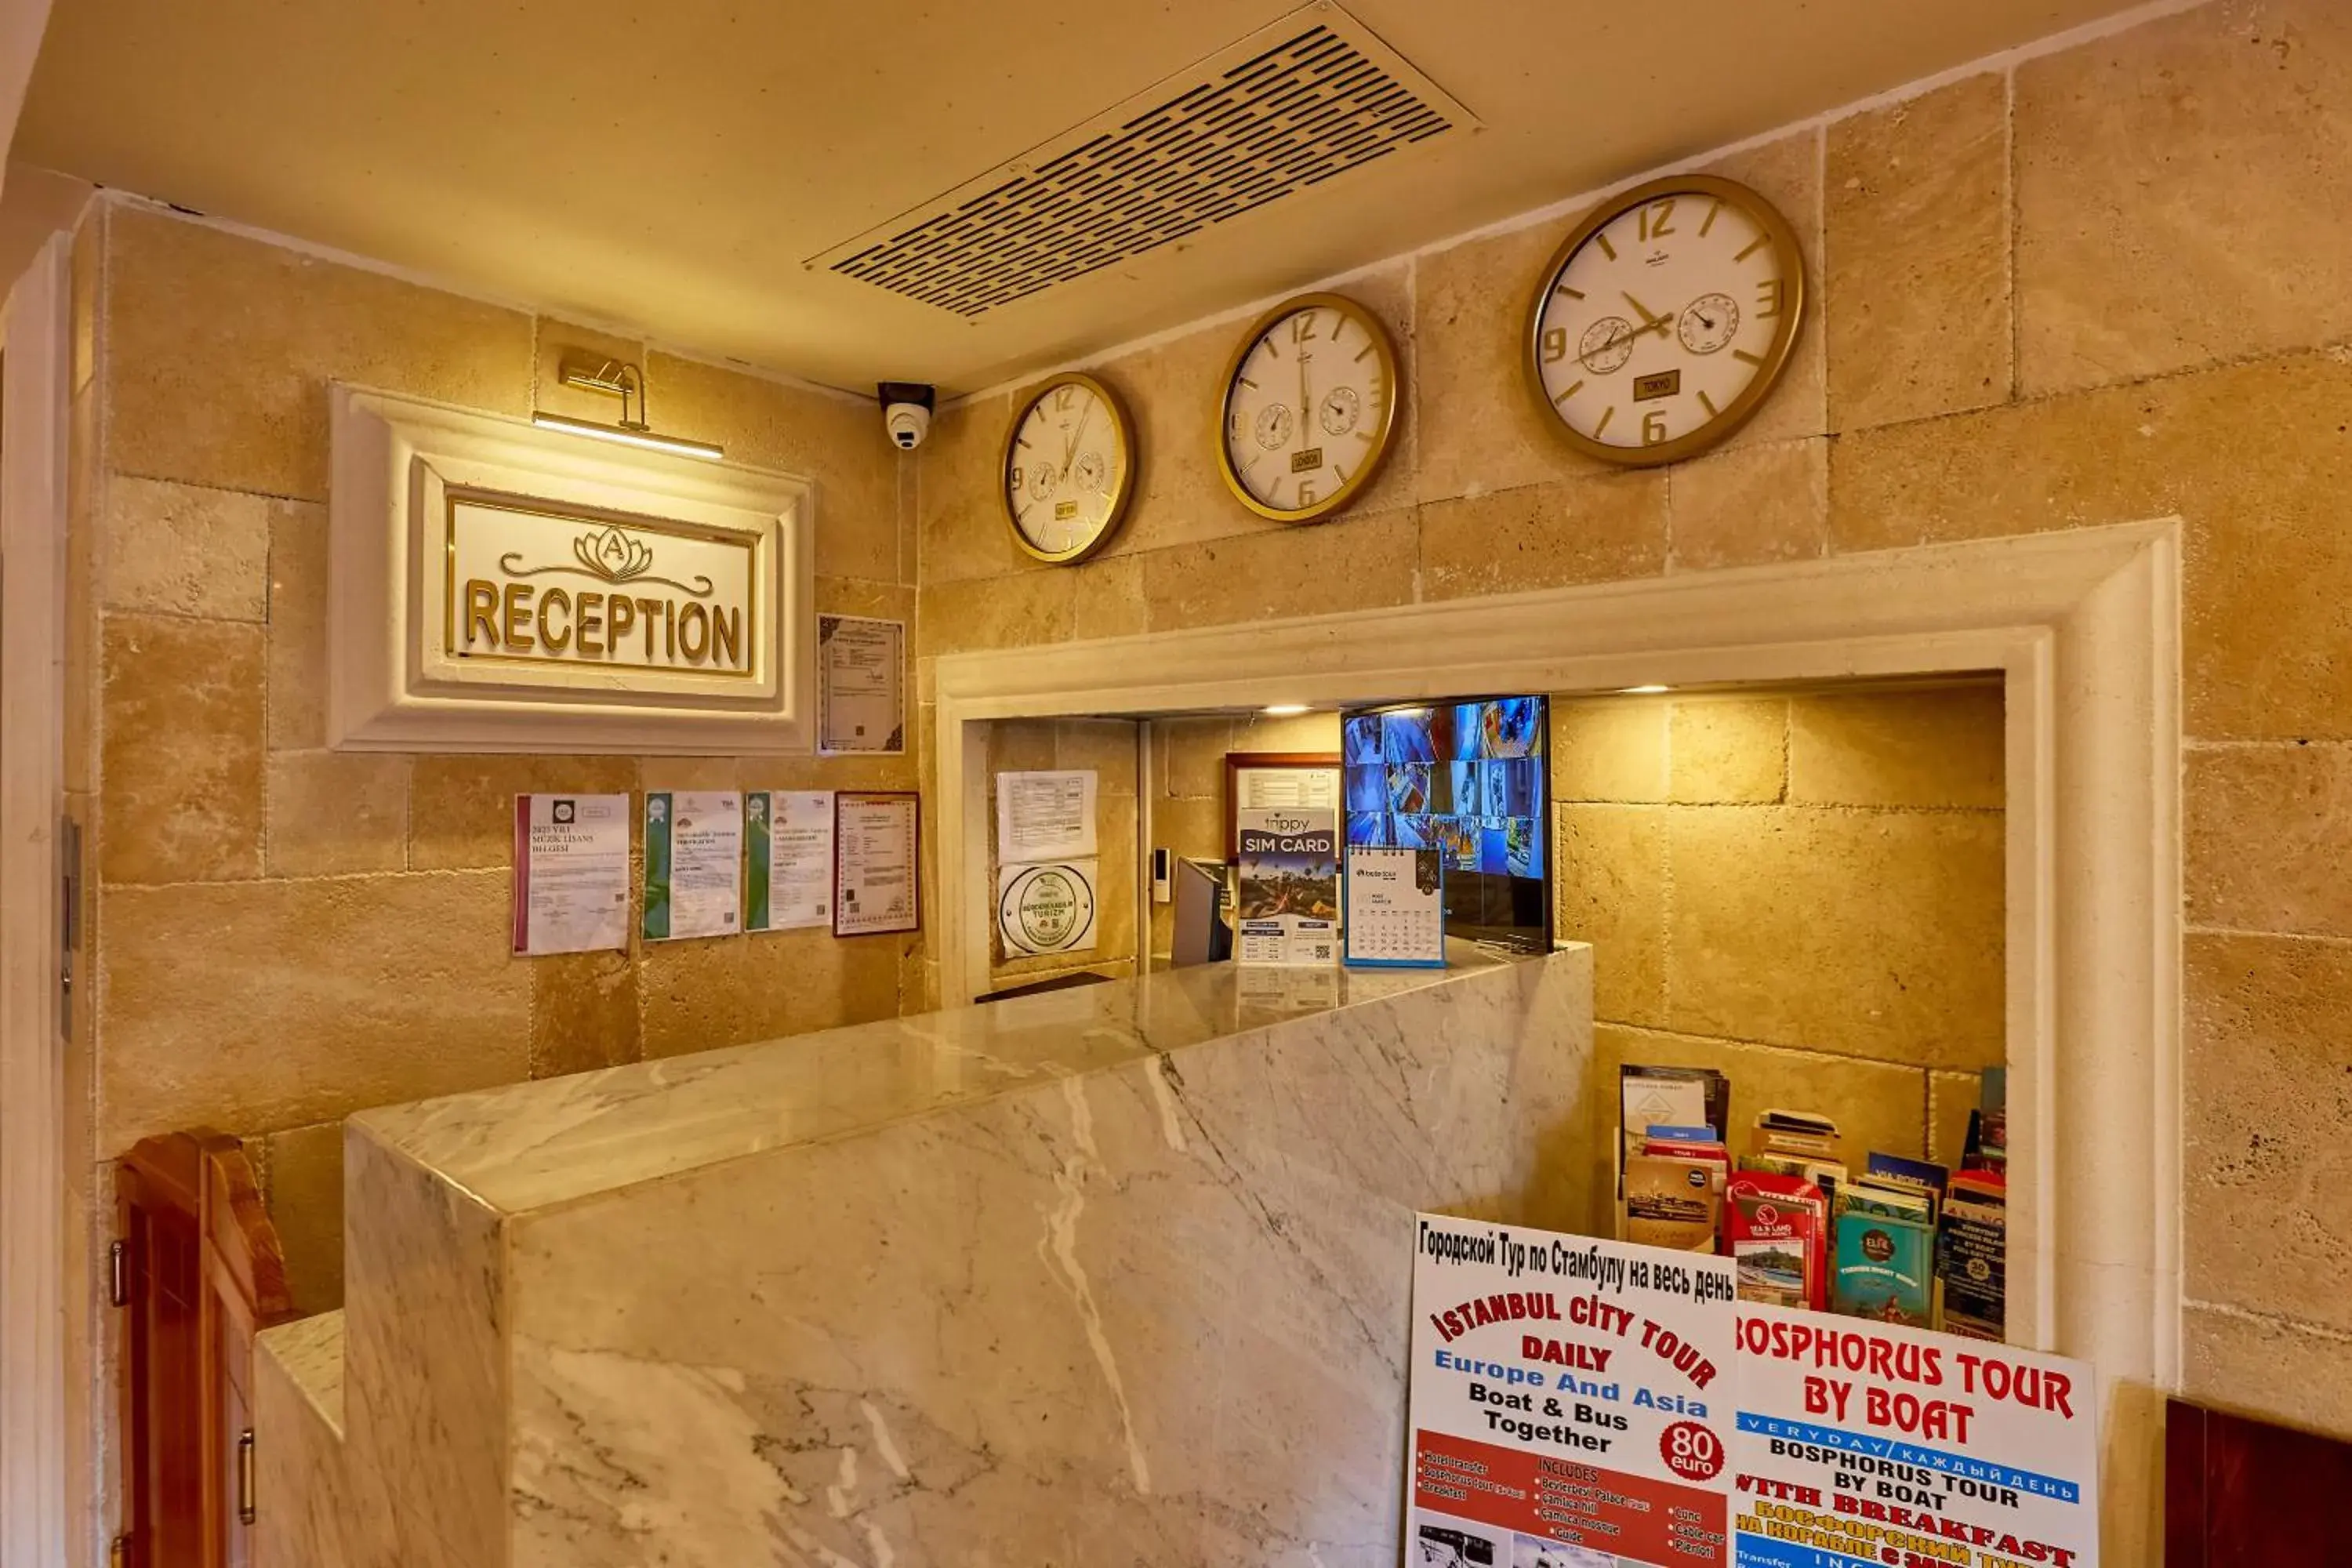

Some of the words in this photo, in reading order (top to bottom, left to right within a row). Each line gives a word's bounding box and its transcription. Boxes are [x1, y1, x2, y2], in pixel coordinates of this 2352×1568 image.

[1639, 200, 1676, 242] 12
[1293, 311, 1316, 343] 12
[1642, 410, 1667, 445] 6
[603, 533, 625, 559] A
[467, 579, 739, 664] RECEPTION
[1265, 812, 1310, 831] trippy
[1245, 838, 1276, 852] SIM
[1280, 838, 1330, 852] CARD
[1419, 1221, 1496, 1266] Городской
[1499, 1232, 1526, 1278] Тур
[1530, 1245, 1547, 1273] по
[1552, 1240, 1625, 1294] Стамбулу
[1630, 1259, 1649, 1289] на
[1653, 1263, 1690, 1294] весь
[1694, 1270, 1734, 1305] день
[1522, 1334, 1613, 1373] DAILY
[1640, 1319, 1717, 1390] TOUR
[1736, 1316, 1942, 1386] OSPHORUS
[1956, 1352, 2074, 1420] TOUR
[1436, 1349, 1544, 1386] Europe
[1556, 1373, 1620, 1402] And
[1633, 1388, 1708, 1418] Asia
[1469, 1383, 1533, 1413] Boat
[1543, 1398, 1563, 1418] &
[1574, 1404, 1629, 1432] Bus
[1803, 1376, 1852, 1422] BY
[1866, 1386, 1975, 1444] BOAT
[1483, 1410, 1613, 1454] Together
[1671, 1426, 1714, 1459] 80
[1538, 1459, 1598, 1483] INCLUDES
[1671, 1457, 1714, 1475] euro
[1769, 1439, 1932, 1486] BOSPHORUS
[1940, 1474, 2020, 1508] TOUR
[2010, 1474, 2073, 1499] ДЕНЬ
[1834, 1472, 1867, 1494] BY
[1876, 1480, 1947, 1510] BOAT
[1755, 1500, 1972, 1566] БОСФОРСКИЙ
[1766, 1519, 1878, 1560] КОРАБЛЕ
[1832, 1493, 2076, 1568] BREAKFAST
[1737, 1550, 1792, 1568] Transfer
